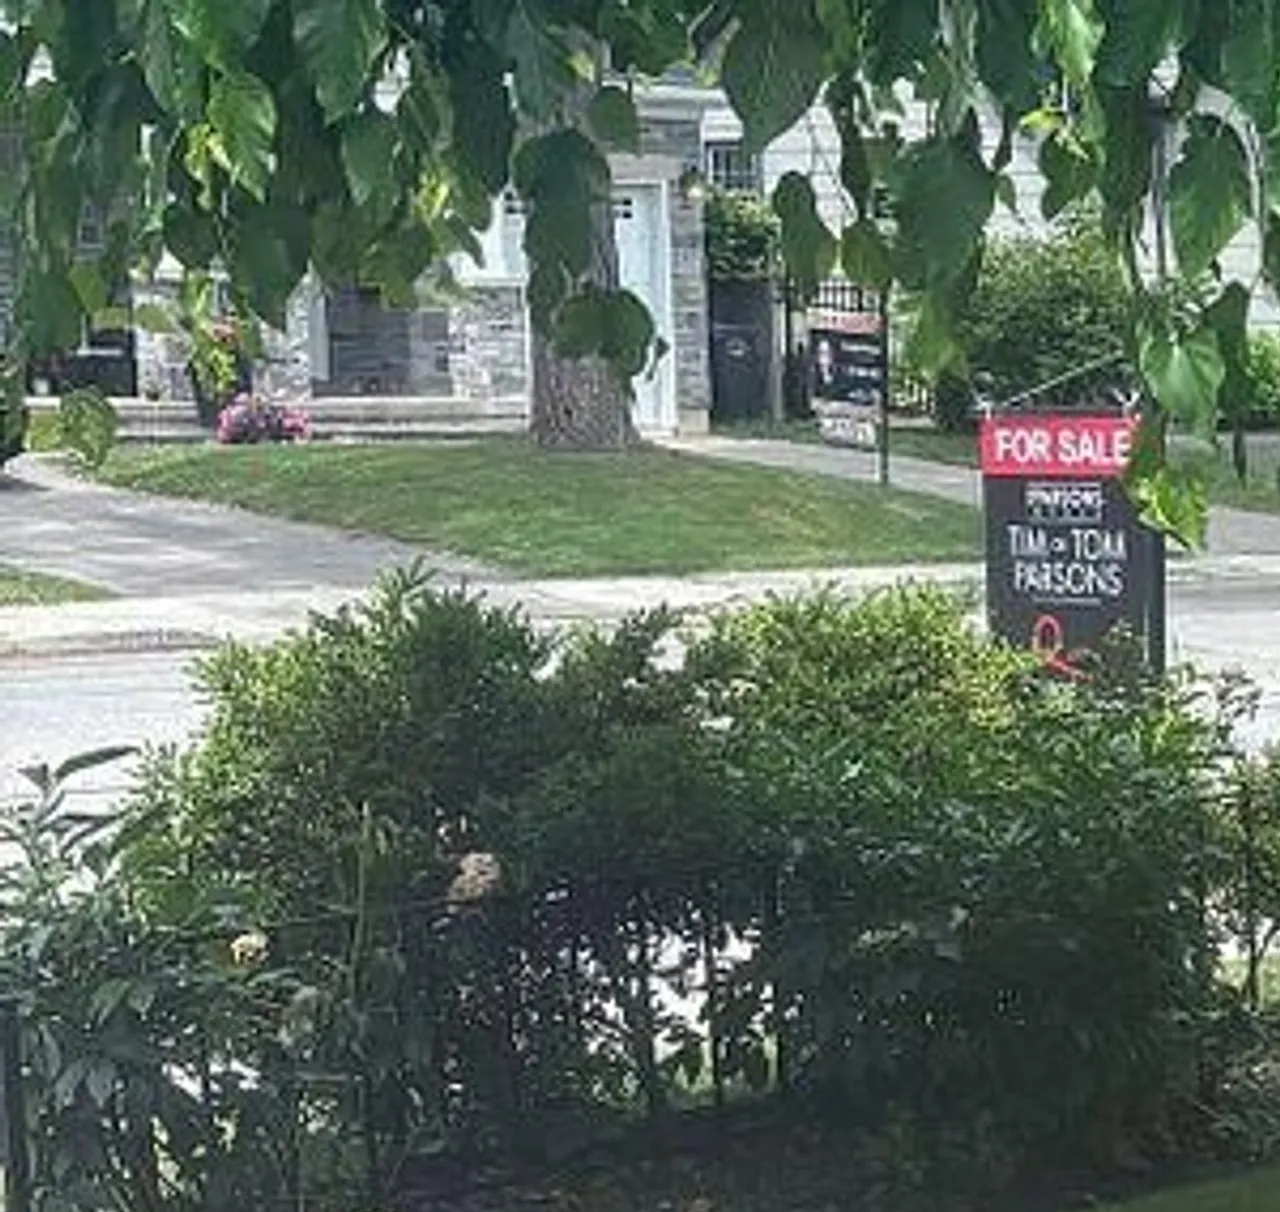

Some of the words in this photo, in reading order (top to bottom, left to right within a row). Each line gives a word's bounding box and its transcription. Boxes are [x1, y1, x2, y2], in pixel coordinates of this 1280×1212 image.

[993, 429, 1050, 463] FOR
[1057, 429, 1132, 466] SALE
[1006, 525, 1048, 556] TIM
[1070, 528, 1127, 560] TOM
[1014, 561, 1124, 596] PARSONS
